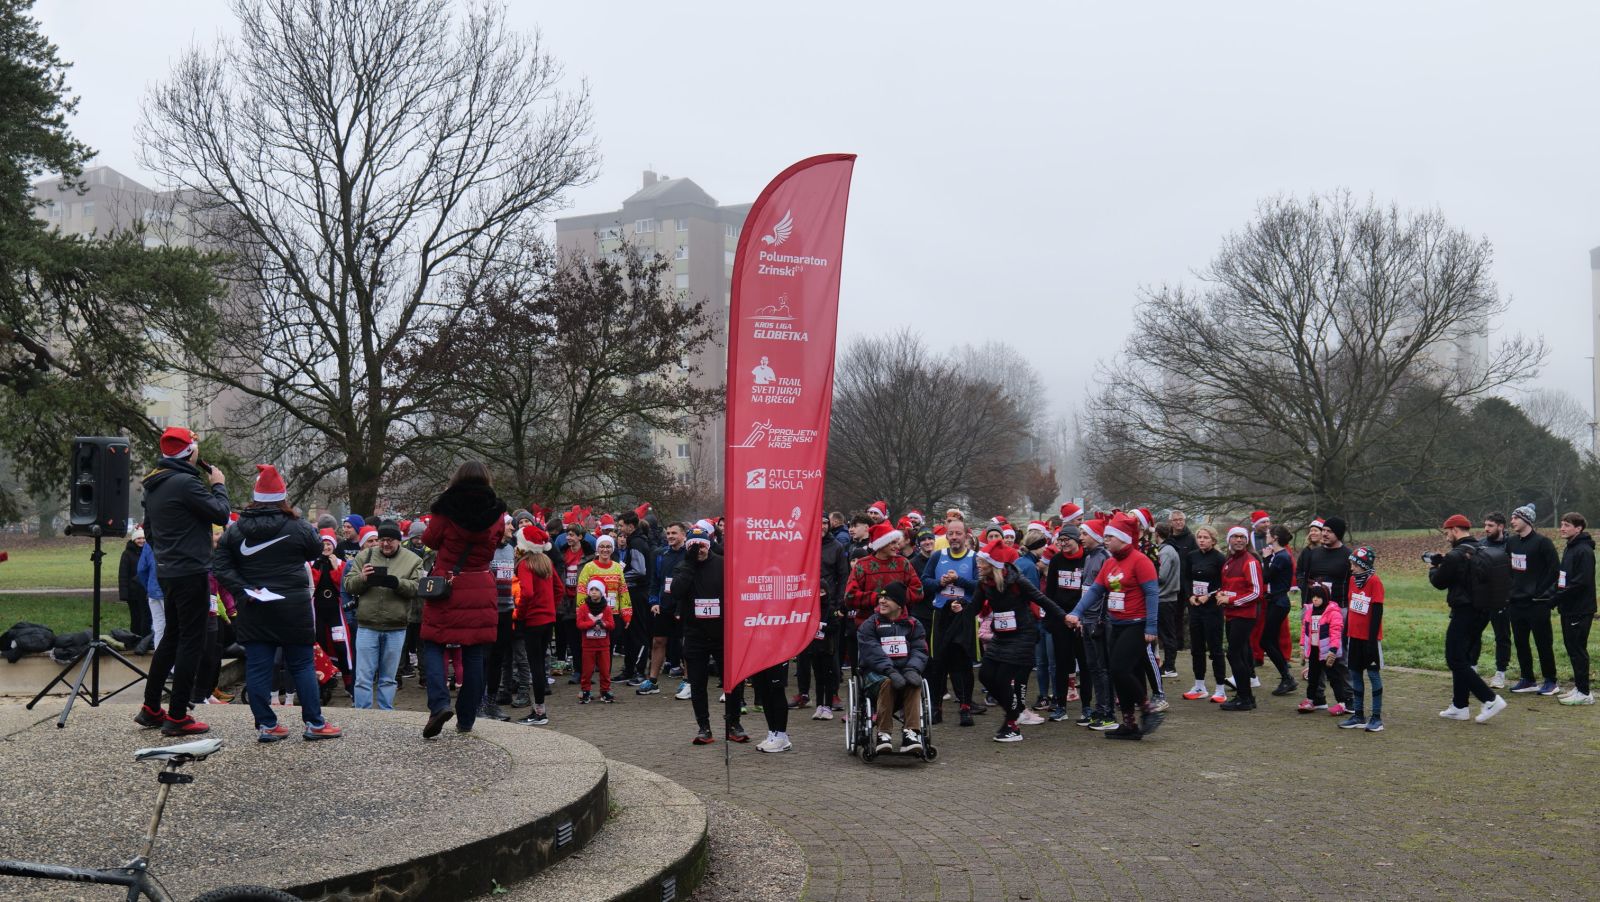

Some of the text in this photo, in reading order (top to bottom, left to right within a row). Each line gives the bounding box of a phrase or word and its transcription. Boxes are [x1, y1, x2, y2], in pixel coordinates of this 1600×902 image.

[759, 251, 828, 266] Polumaraton
[754, 321, 792, 330] KROS LIGA
[753, 329, 809, 342] GLOBETKA
[778, 377, 802, 387] TRAIL
[751, 385, 802, 397] SVETI JURAJ
[751, 395, 795, 405] NA BREGU
[771, 435, 813, 443] JESENSKI
[768, 468, 822, 479] ATLETSKA
[768, 478, 804, 490] ŠKOLA
[746, 517, 785, 529] ŠKOLA
[746, 529, 803, 542] TRČANJA
[747, 575, 773, 584] ATLETSKI
[759, 584, 773, 592] KLUB
[950, 587, 955, 595] 5
[702, 607, 712, 615] 41
[743, 610, 811, 627] akm.hr
[999, 620, 1008, 629] 29
[889, 644, 900, 654] 45
